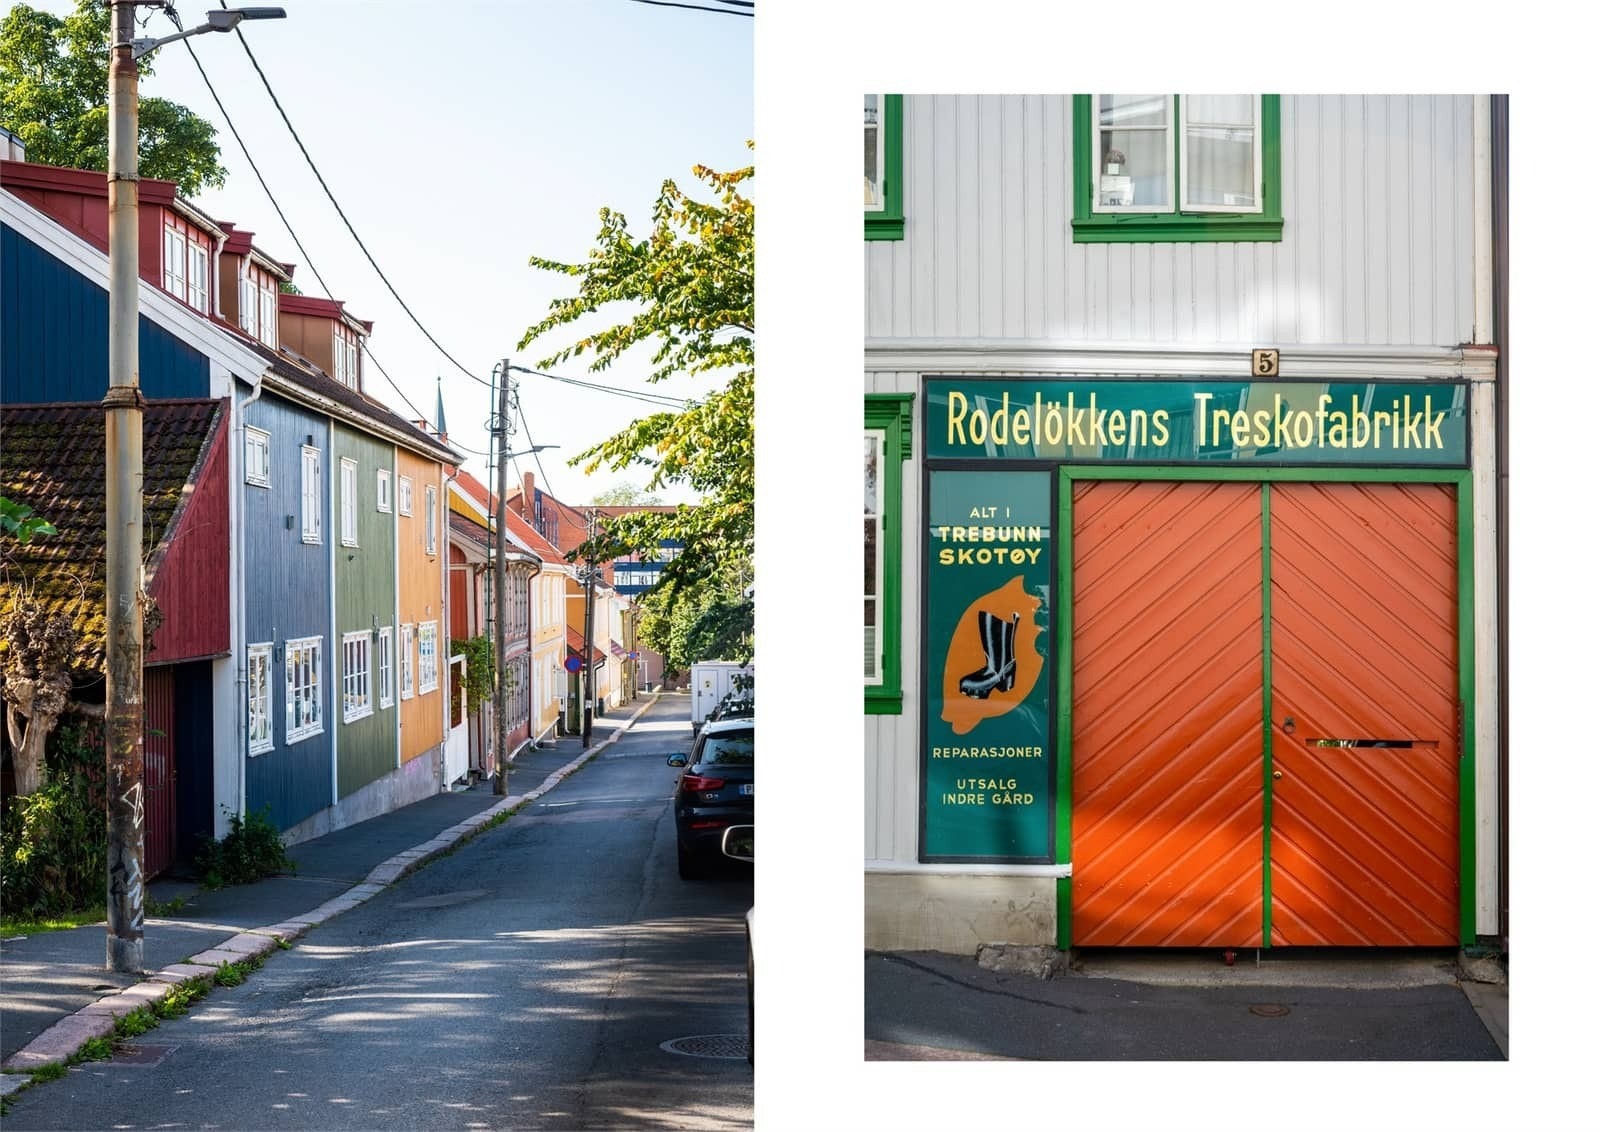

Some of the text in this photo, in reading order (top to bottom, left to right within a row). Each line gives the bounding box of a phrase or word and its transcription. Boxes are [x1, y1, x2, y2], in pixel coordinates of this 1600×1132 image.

[1259, 353, 1273, 373] 5
[947, 391, 1446, 449] Rodelökkens Treskofabrikk
[969, 506, 1010, 518] ALT I
[938, 526, 1041, 542] TREBUNN
[939, 547, 1042, 565] SKOTØY
[932, 747, 1043, 758] REPARASJONER
[957, 778, 1017, 790] UTSALG
[942, 791, 1034, 805] INDRE GÅRD
